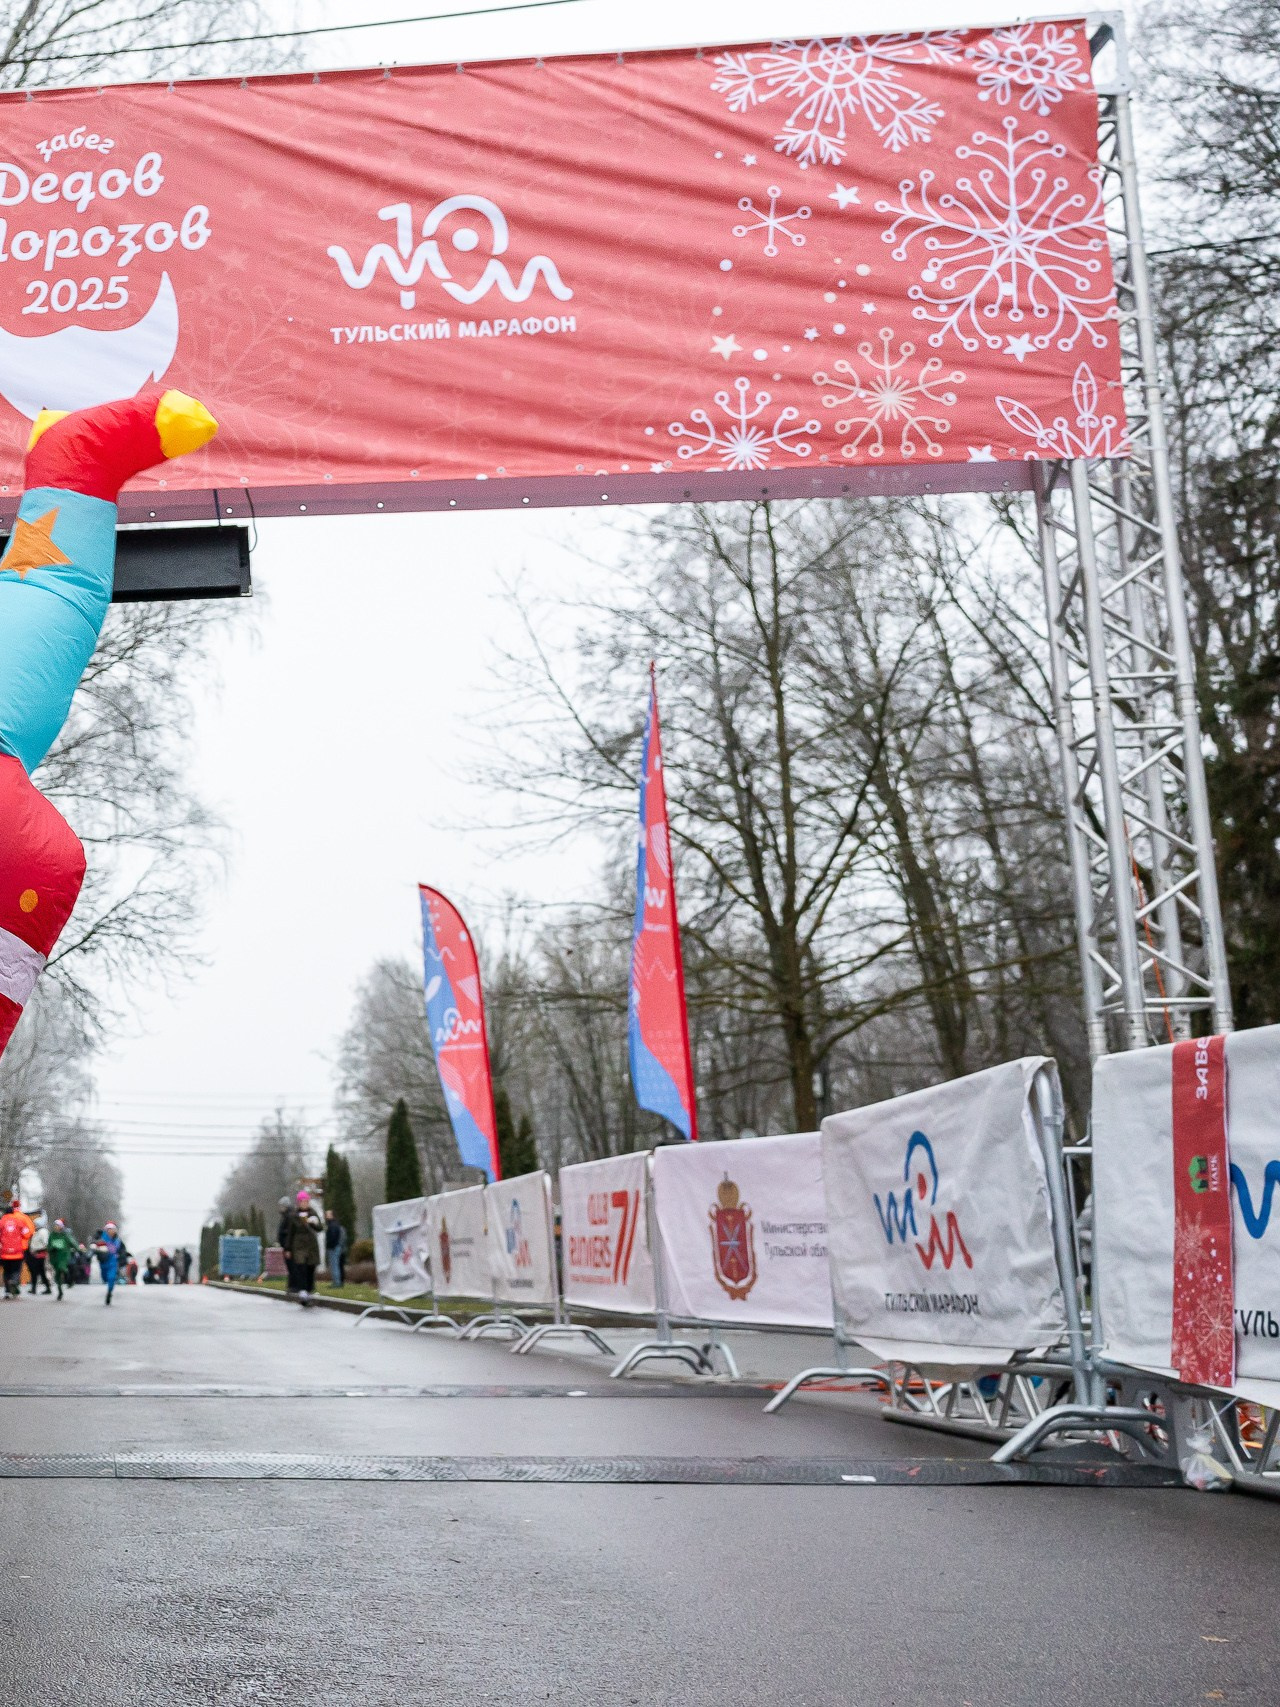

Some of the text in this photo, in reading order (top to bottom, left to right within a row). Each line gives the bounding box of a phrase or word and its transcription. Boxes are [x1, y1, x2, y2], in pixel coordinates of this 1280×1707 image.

[36, 125, 115, 163] забег
[21, 275, 130, 315] 2025
[329, 314, 577, 345] ТУЛЬСКИЙ МАРАФОН
[1234, 1308, 1280, 1338] УЛЬ
